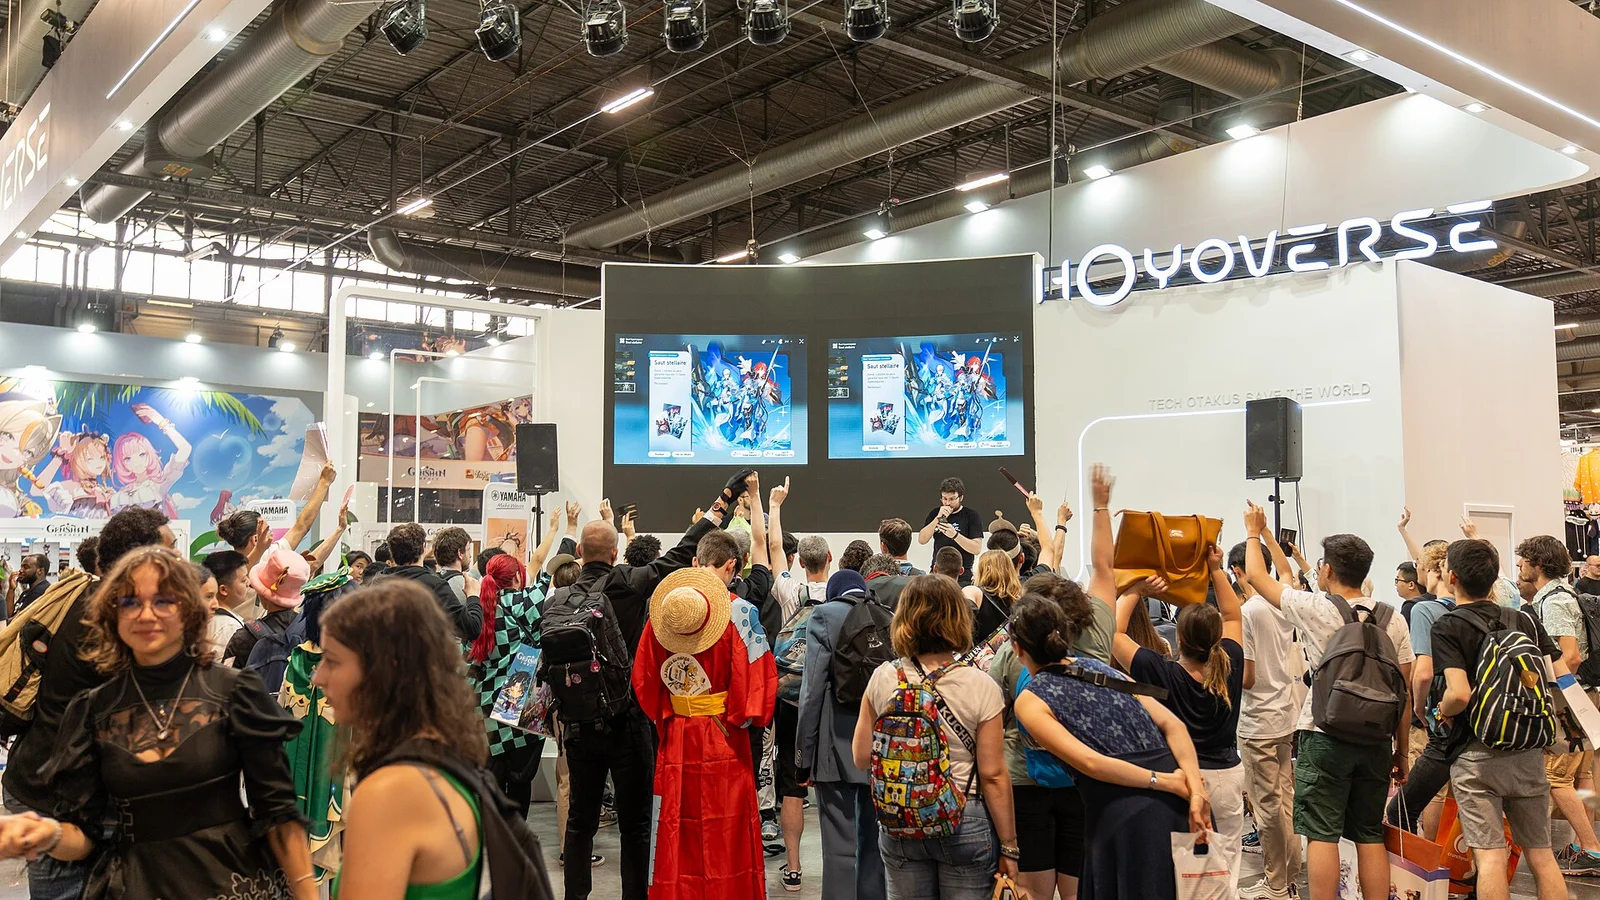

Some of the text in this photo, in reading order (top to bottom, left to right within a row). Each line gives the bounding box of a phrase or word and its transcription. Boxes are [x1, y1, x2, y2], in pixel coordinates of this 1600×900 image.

[1036, 200, 1498, 307] HOYOVERSE
[1149, 383, 1371, 411] TECH OTAKUS SAVE THE WORLD
[499, 491, 527, 502] YAMAHA
[260, 506, 289, 515] YAMAHA
